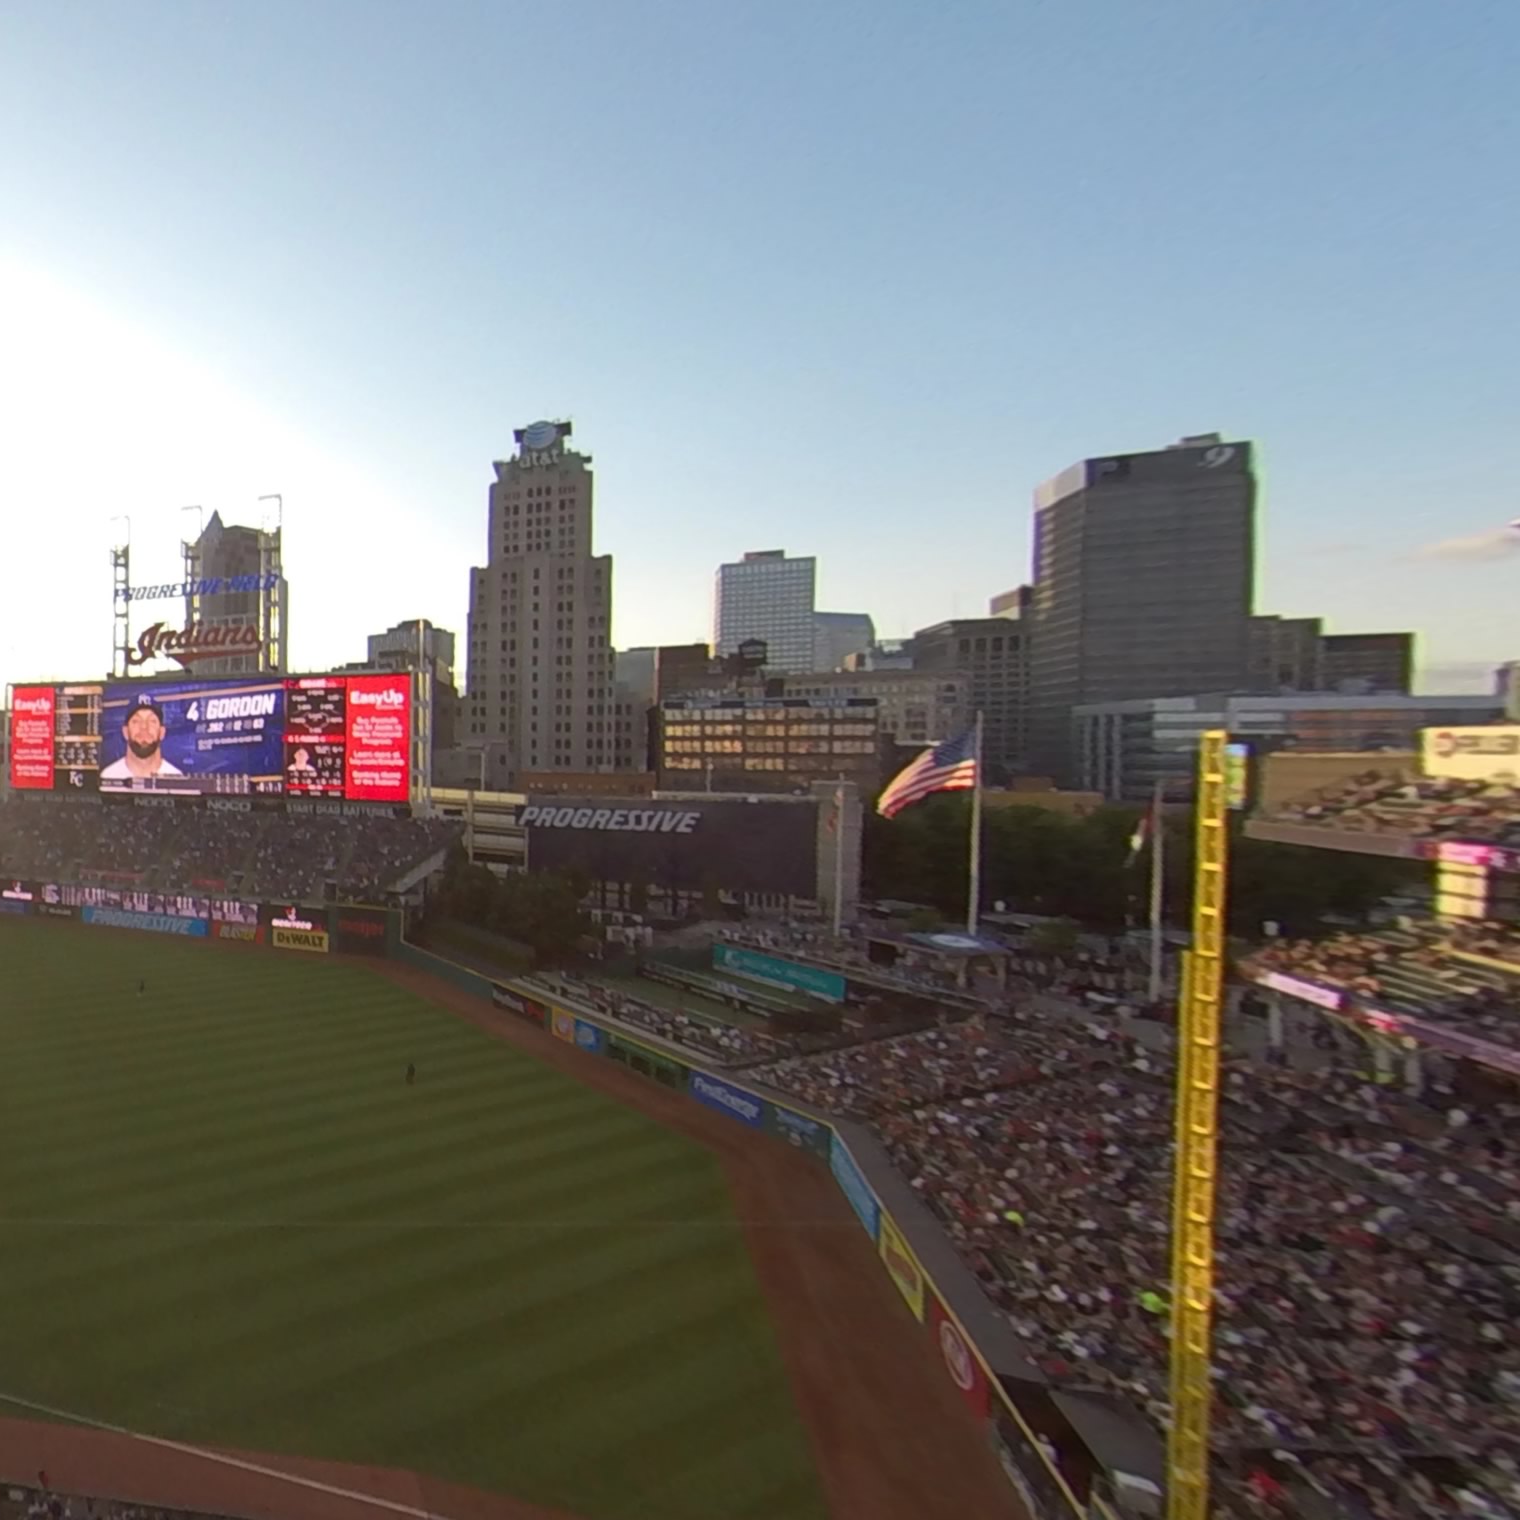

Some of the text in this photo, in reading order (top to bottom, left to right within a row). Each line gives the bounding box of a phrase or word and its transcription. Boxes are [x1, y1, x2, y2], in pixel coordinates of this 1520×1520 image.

[127, 621, 262, 665] Indians
[186, 701, 199, 721] 4
[206, 692, 276, 720] GORDON
[350, 689, 404, 706] EasyUp
[134, 797, 175, 808] NOCO
[207, 799, 251, 811] NOCO
[519, 806, 701, 833] PROGRESSIVE
[91, 909, 192, 934] PROGRESSIVE
